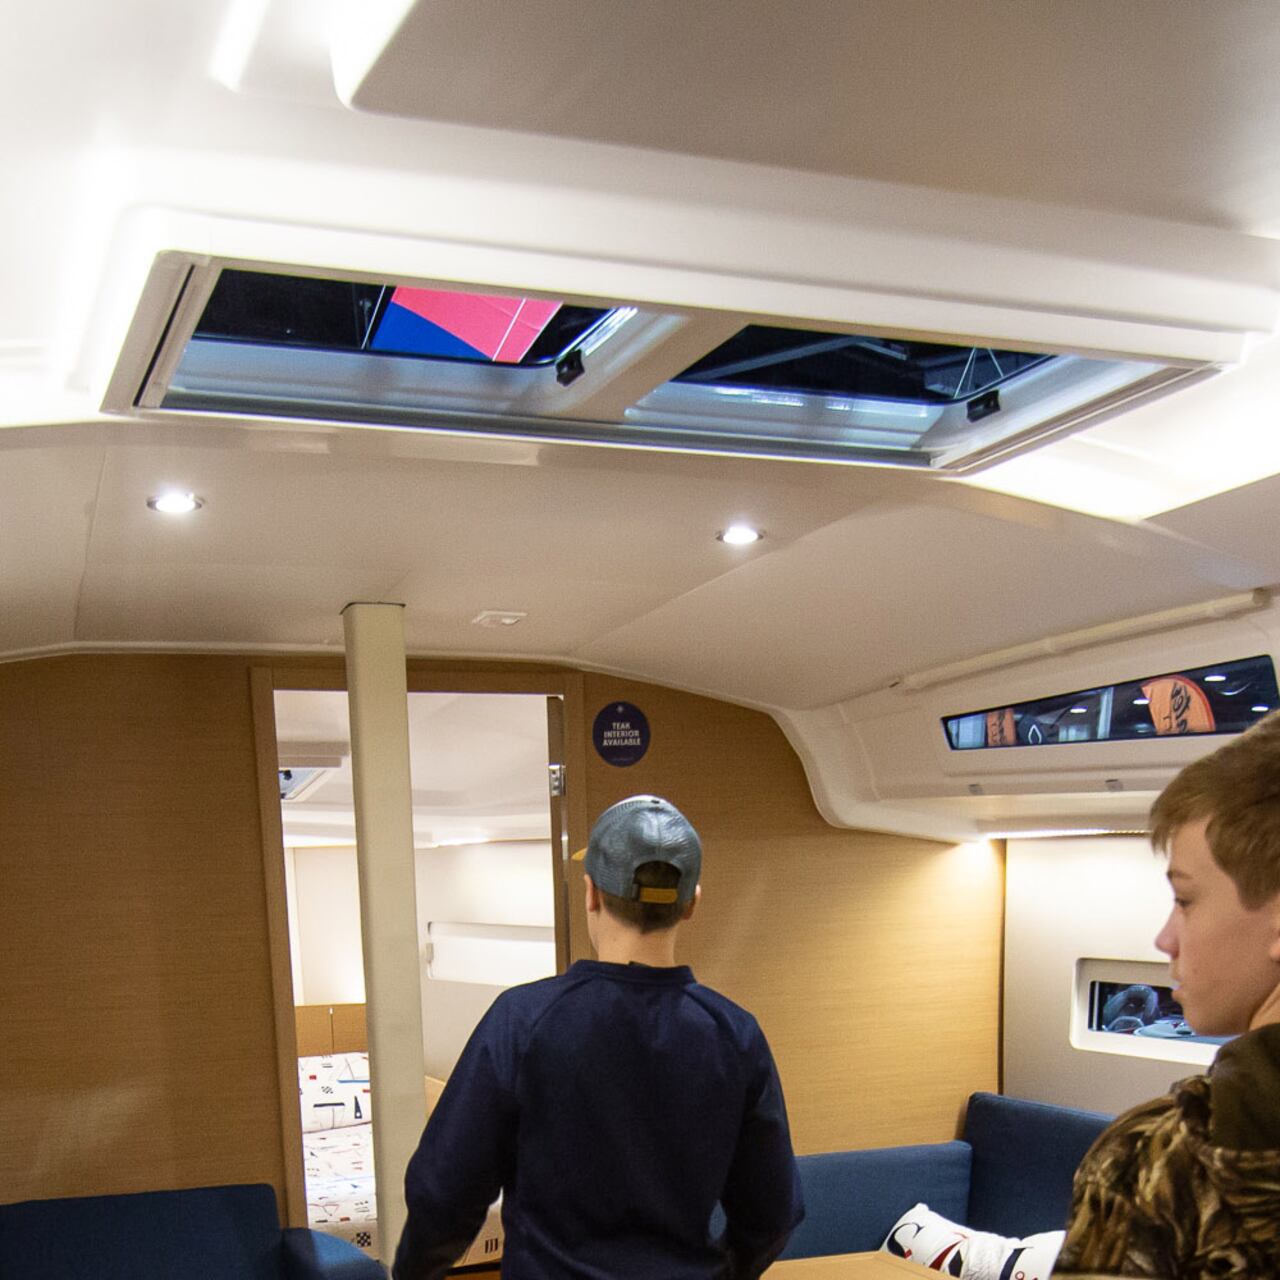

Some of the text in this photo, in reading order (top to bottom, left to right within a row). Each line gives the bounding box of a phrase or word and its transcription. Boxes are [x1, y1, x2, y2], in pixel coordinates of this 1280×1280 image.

[612, 722, 631, 730] TEAK
[604, 730, 640, 738] INTERIOR
[603, 737, 641, 746] AVAILABLE
